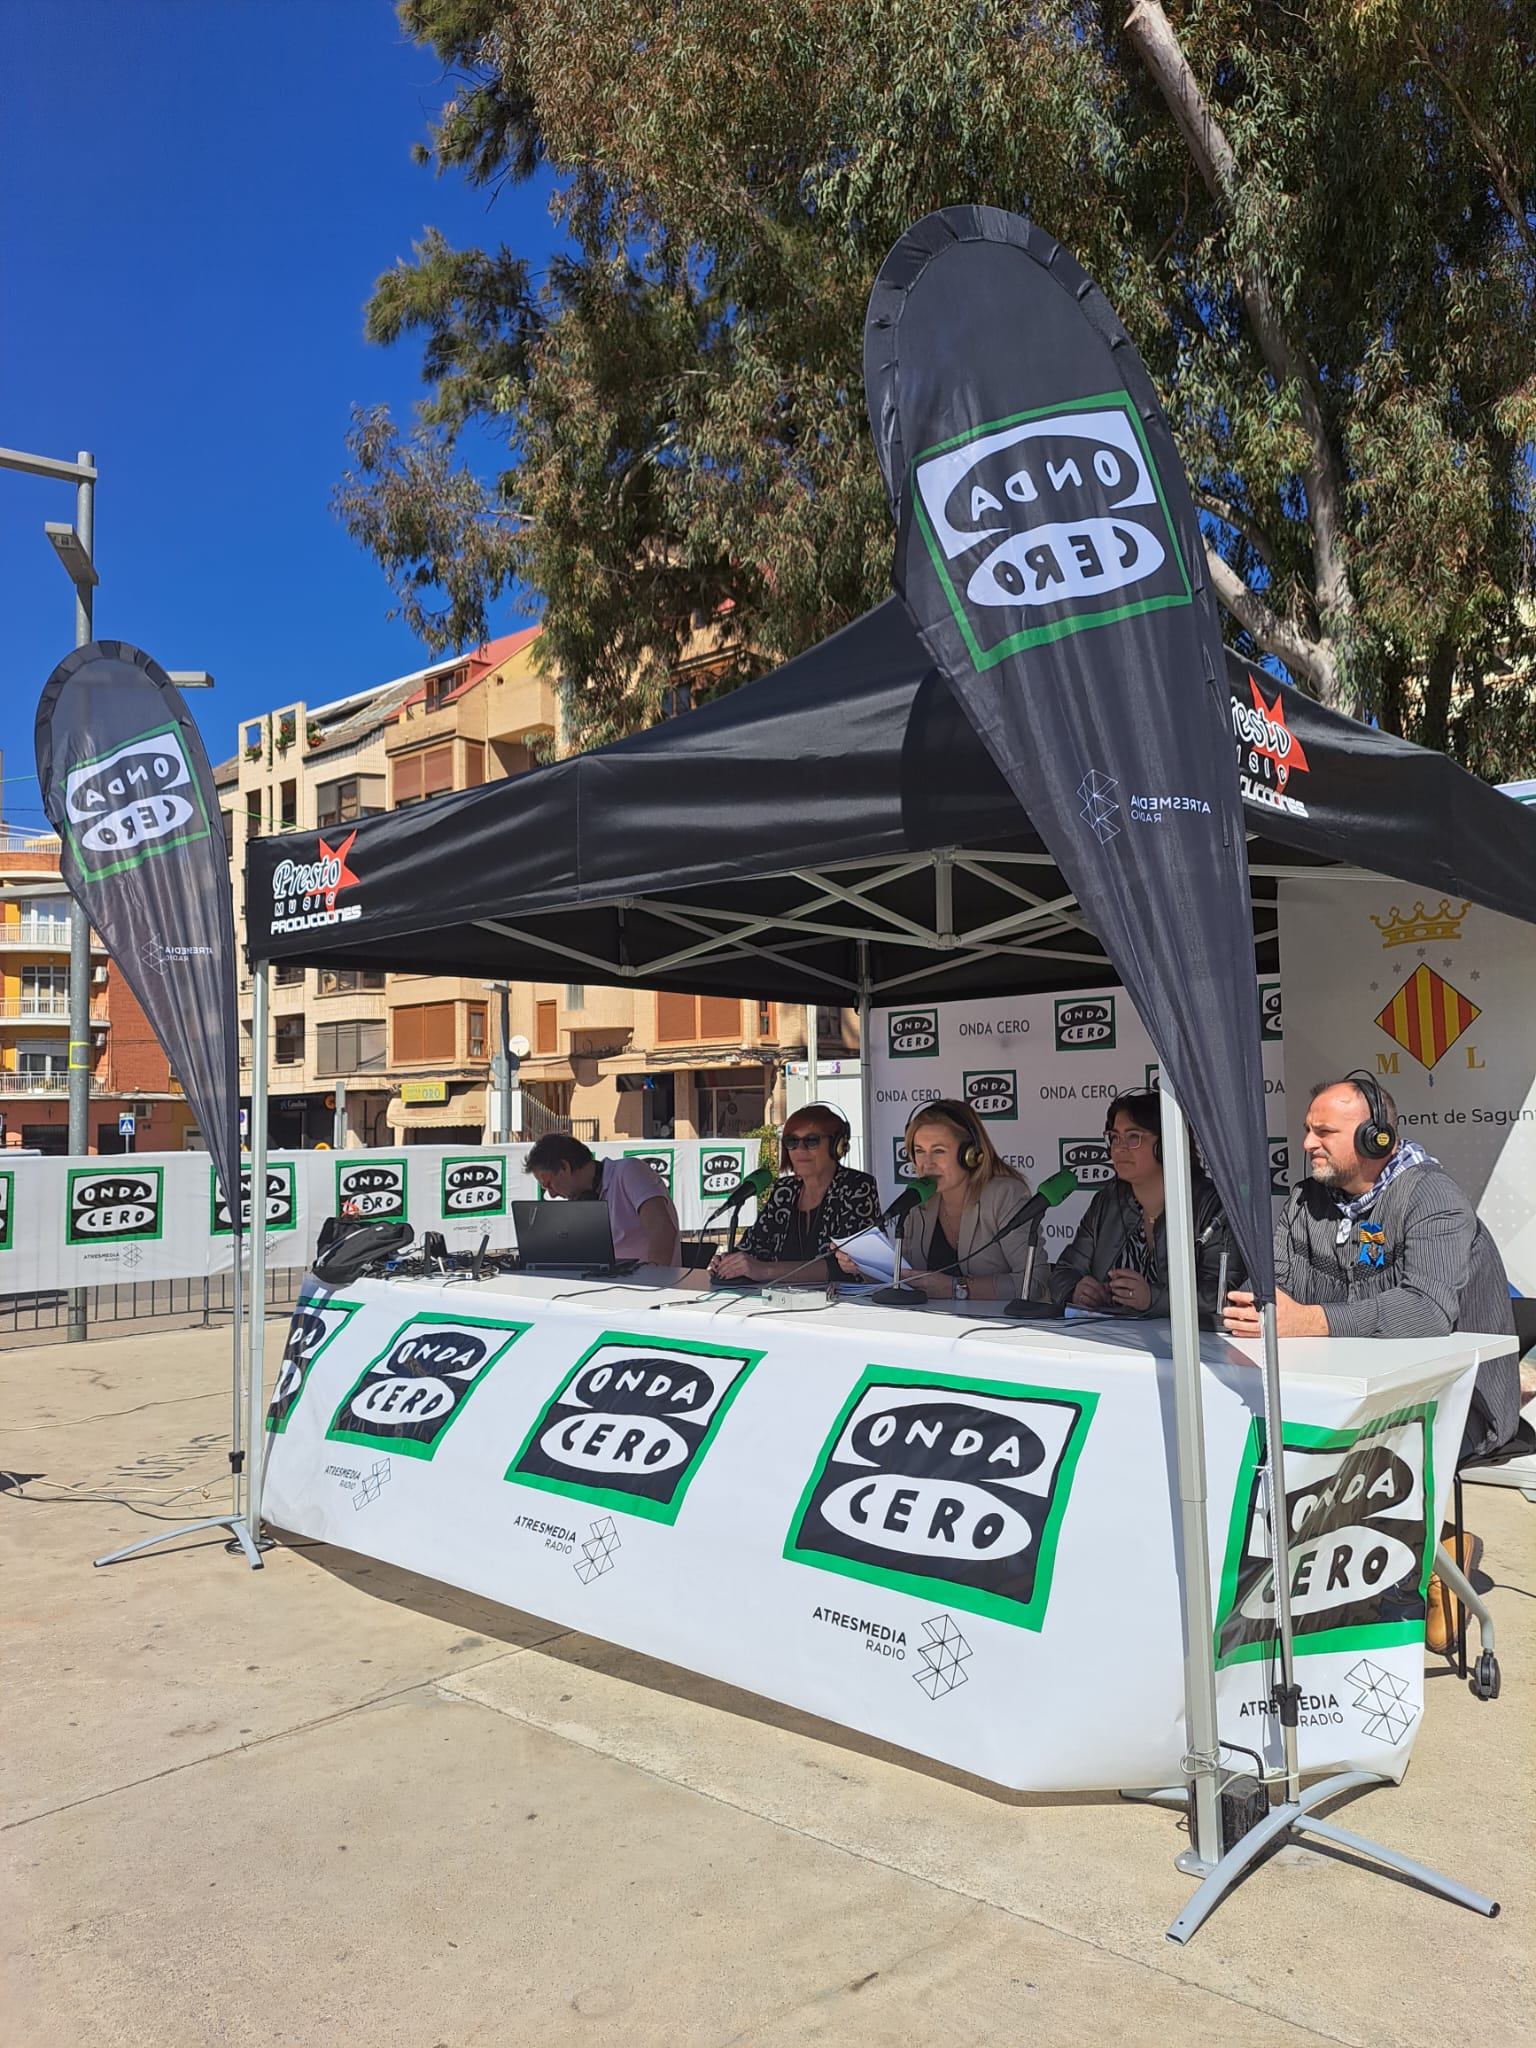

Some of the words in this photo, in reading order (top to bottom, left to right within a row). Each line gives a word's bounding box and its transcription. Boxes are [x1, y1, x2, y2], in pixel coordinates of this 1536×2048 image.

[272, 854, 341, 900] Presto
[274, 891, 335, 917] MUSIC
[1064, 1008, 1104, 1022] ONDA
[895, 1020, 930, 1032] ONDA
[959, 1022, 993, 1036] ONDA
[996, 1020, 1030, 1034] CERO
[1067, 1027, 1105, 1040] CERO
[899, 1036, 930, 1048] CERO
[1376, 1052, 1401, 1075] M
[1466, 1046, 1486, 1069] L
[971, 1081, 1007, 1092] ONDA
[1040, 1086, 1077, 1100] ONDA
[1082, 1084, 1118, 1099] CERO
[1264, 1080, 1285, 1094] DA
[876, 1090, 906, 1103] ONDA
[911, 1088, 942, 1101] CERO
[974, 1099, 1007, 1110] CERO
[1444, 1109, 1466, 1124] de
[1472, 1108, 1536, 1126] Sagun
[1069, 1150, 1109, 1160] ONDA
[707, 1160, 737, 1170] ONDA
[452, 1170, 494, 1184] ONDA
[1074, 1168, 1109, 1179] ERO
[348, 1175, 394, 1189] ONDA
[709, 1177, 735, 1188] CERO
[84, 1184, 146, 1201] ONDA
[456, 1190, 494, 1204] CERO
[87, 1210, 145, 1227] CERO
[1046, 1225, 1074, 1239] OND
[289, 1328, 317, 1345] DA
[397, 1341, 474, 1367] ONDA
[589, 1367, 698, 1405] ONDA
[366, 1384, 445, 1417] CERO
[561, 1419, 671, 1465] CERO
[868, 1415, 1021, 1468] ONDA
[1291, 1467, 1397, 1533] ONDA
[849, 1483, 1005, 1549] CERO
[513, 1515, 577, 1543] ATRESMEDIA
[544, 1538, 572, 1555] RADIO
[812, 1605, 907, 1646] ATRESMEDIA
[865, 1639, 906, 1661] RADIO
[1300, 1711, 1344, 1727] RADIO
